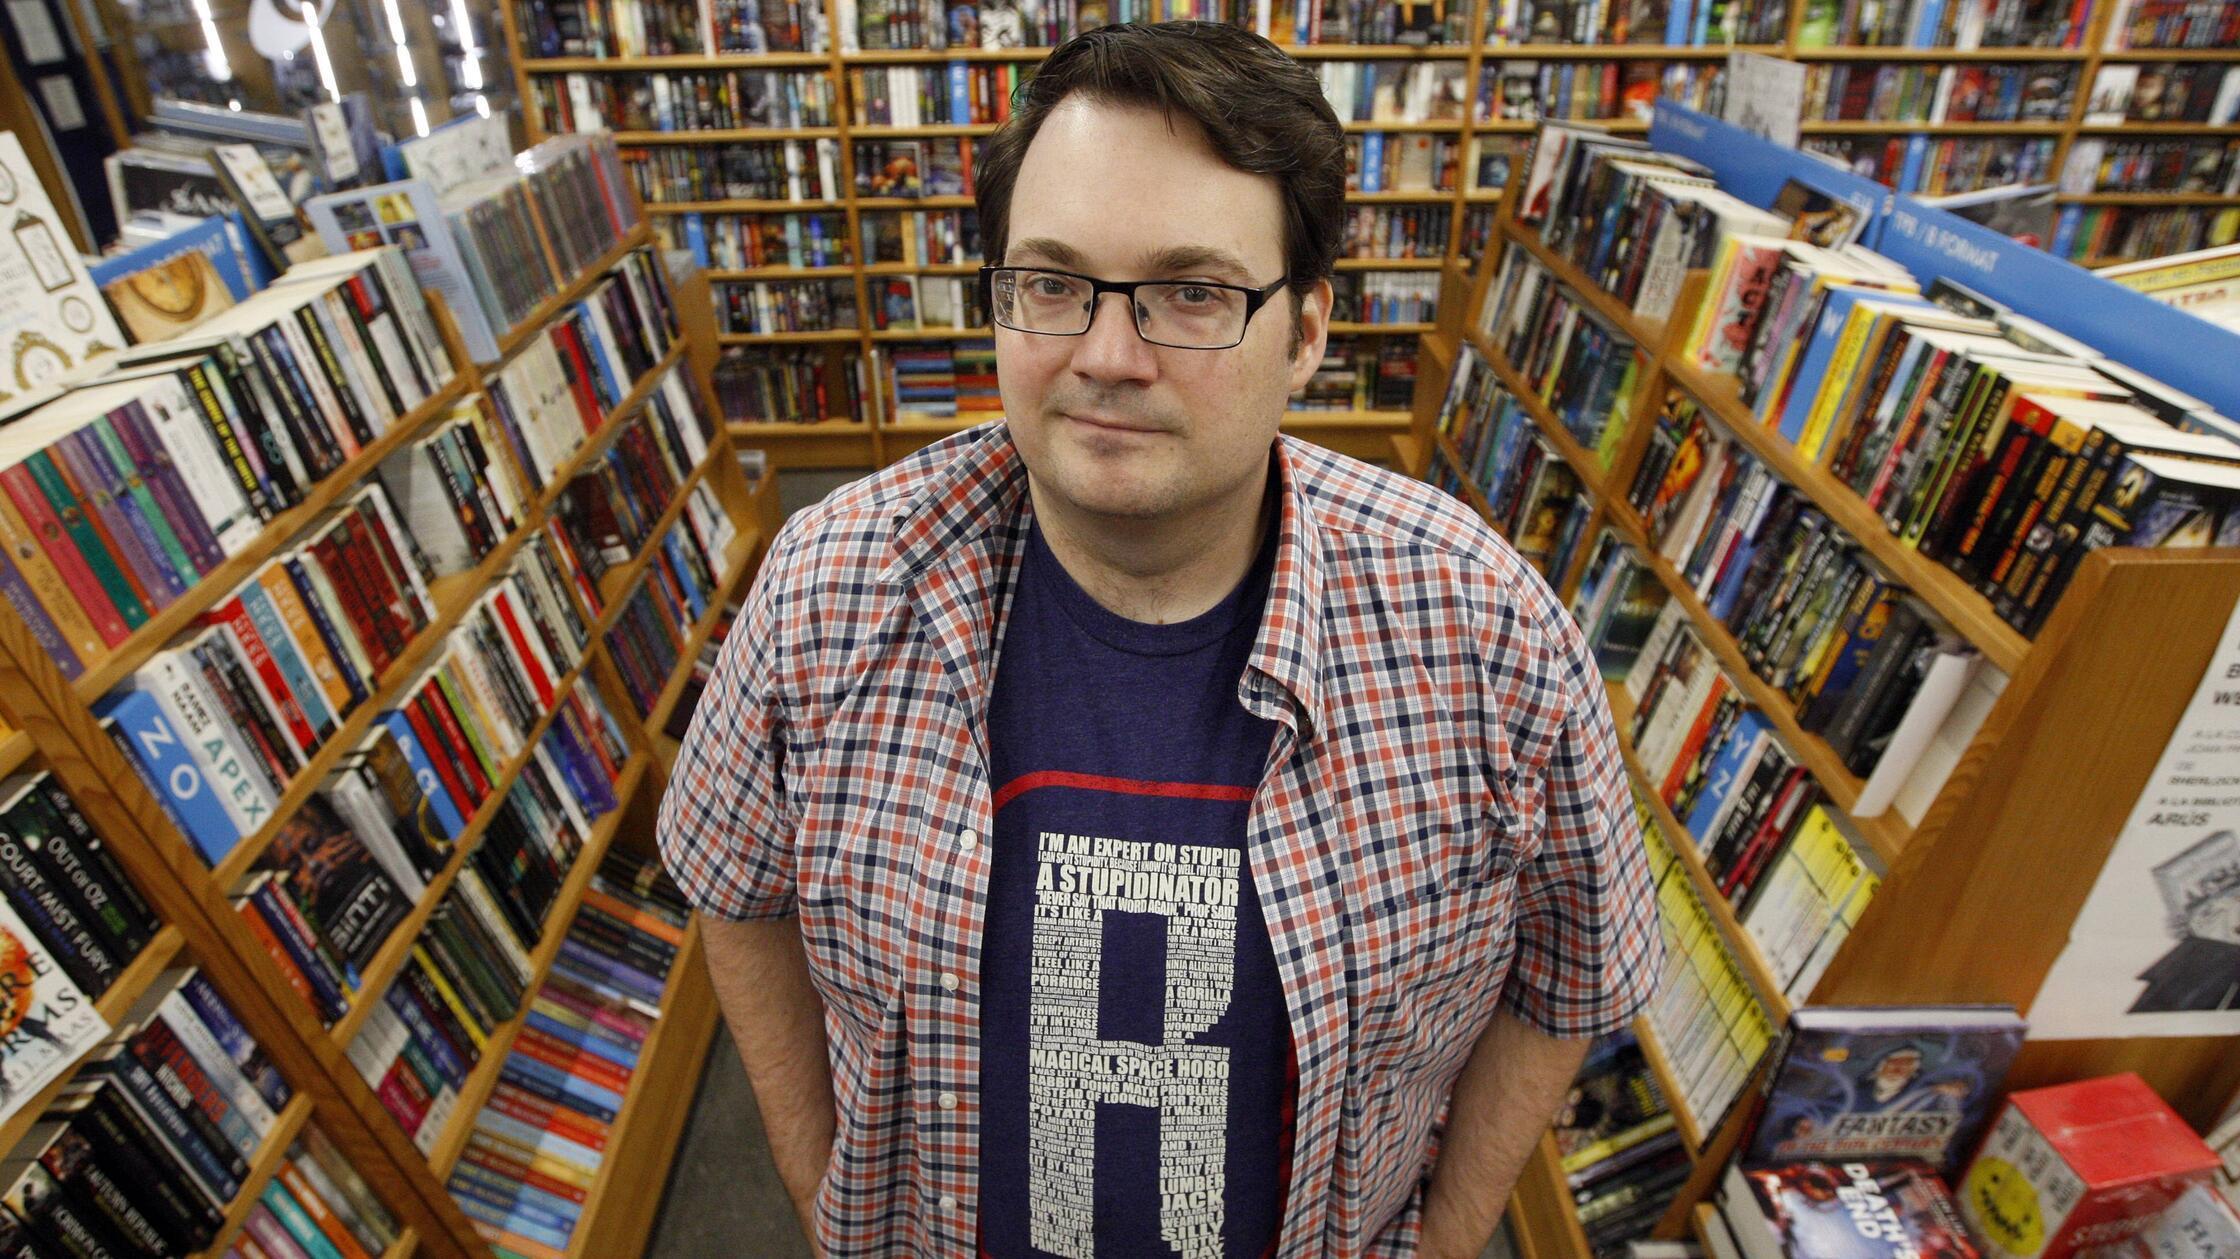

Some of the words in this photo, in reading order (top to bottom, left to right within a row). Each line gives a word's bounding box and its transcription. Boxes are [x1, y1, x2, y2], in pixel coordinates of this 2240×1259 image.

[1938, 230, 1999, 272] FORMAT
[1731, 732, 1752, 760] Y
[205, 737, 265, 825] APEX
[1711, 769, 1731, 798] Z
[1039, 832, 1064, 852] I'M
[1067, 834, 1090, 853] AN
[1094, 837, 1151, 860] EXPERT
[1154, 842, 1175, 862] ON
[1180, 845, 1241, 866] STUPID
[48, 836, 82, 873] OUT
[84, 883, 108, 910] OZ
[1038, 851, 1041, 862] I
[1041, 851, 1056, 863] CAN
[1056, 852, 1073, 865] SPOT
[1109, 857, 1137, 872] BECAUSE
[1141, 860, 1160, 873] KNOW
[1161, 862, 1168, 873] IT
[1168, 862, 1177, 875] SO
[1196, 865, 1207, 876] I'M
[1207, 865, 1221, 878] LIKE
[1036, 863, 1053, 890] A
[1060, 864, 1239, 906] STUPIDINATOR
[0, 832, 45, 891] COURT
[39, 891, 79, 933] MIST
[73, 929, 113, 974] FURY
[1072, 893, 1091, 908] SAY
[1092, 895, 1118, 910] THAT
[1118, 898, 1147, 913] WORD
[1184, 903, 1210, 918] PROF
[1211, 905, 1237, 920] SAID.
[1034, 904, 1059, 918] IT'S
[1062, 906, 1091, 920] LIKE
[1093, 909, 1103, 921] A
[1167, 916, 1171, 925] I
[1172, 917, 1192, 926] HAD
[1193, 918, 1205, 927] TO
[1206, 919, 1237, 930] STUDY
[1167, 925, 1190, 936] LIKE
[1191, 927, 1199, 937] A
[1200, 928, 1236, 940] HORSE
[1033, 935, 1063, 945] CREEPY
[1063, 937, 1102, 948] ARTERIES
[1031, 956, 1036, 967] I
[1039, 957, 1063, 969] FEEL
[1065, 959, 1090, 970] LIKE
[1092, 960, 1100, 971] A
[1032, 949, 1058, 958] CHUNK
[1059, 951, 1068, 959] OF
[1069, 952, 1101, 961] CHICKEN
[1032, 967, 1060, 976] BRICK
[1062, 968, 1087, 978] MADE
[1089, 970, 1100, 979] OF
[1166, 960, 1188, 970] NINJA
[1188, 961, 1234, 974] ALLIGATORS
[1031, 974, 1100, 990] PORRIDGE
[1165, 977, 1191, 986] ACTED
[1214, 981, 1234, 991] WAS
[1166, 970, 1188, 978] SINCE
[1189, 971, 1208, 980] THEN
[1208, 972, 1234, 983] YOU'VE
[1165, 986, 1174, 999] A
[1176, 986, 1231, 1003] GORILLA
[1030, 1004, 1099, 1020] CHIMPANZEES
[1164, 999, 1175, 1008] AT
[1176, 999, 1198, 1009] YOUR
[1200, 1000, 1229, 1011] BUFFET
[1030, 1015, 1048, 1026] I'M
[1050, 1015, 1098, 1030] INTENSE
[1164, 1013, 1184, 1022] LIKE
[1184, 1014, 1192, 1023] A
[1193, 1014, 1218, 1024] DEAD
[1164, 1022, 1211, 1033] WOMBAT
[1029, 1049, 1112, 1074] MAGICAL
[1116, 1055, 1174, 1079] SPACE
[1177, 1059, 1230, 1079] HOBO
[1029, 1073, 1077, 1088] RABBIT
[1080, 1078, 1120, 1093] DOING
[1122, 1082, 1158, 1097] MATH
[1160, 1084, 1229, 1096] PROBLEMS
[1029, 1084, 1083, 1100] INSTEAD
[1086, 1090, 1101, 1102] OF
[1104, 1093, 1159, 1107] LOOKING
[1161, 1096, 1186, 1106] FOR
[1188, 1096, 1228, 1106] FOXES
[1030, 1094, 1064, 1108] YOU'RE
[1065, 1099, 1087, 1108] LIKE
[1088, 1100, 1095, 1110] A
[1029, 1102, 1095, 1120] POTATO
[1161, 1106, 1172, 1116] IT
[1173, 1106, 1202, 1116] WAS
[1203, 1106, 1228, 1115] LIKE
[1160, 1116, 1176, 1125] ONE
[1176, 1116, 1227, 1125] LUMBERJACK
[1835, 1113, 1949, 1136] FANTASY
[1160, 1140, 1187, 1150] AND
[1190, 1139, 1226, 1150] THEIR
[1030, 1153, 1045, 1167] LIT
[1046, 1158, 1061, 1172] BY
[1062, 1162, 1094, 1177] FRUIT
[1160, 1158, 1173, 1166] TO
[1175, 1156, 1204, 1165] FORM
[1205, 1154, 1225, 1164] ONE
[1160, 1164, 1202, 1178] REALLY
[1204, 1162, 1225, 1175] FAT
[1160, 1173, 1225, 1195] LUMBER
[1162, 1189, 1224, 1211] JACK
[1834, 1186, 1883, 1240] END
[1160, 1220, 1224, 1241] SILLY
